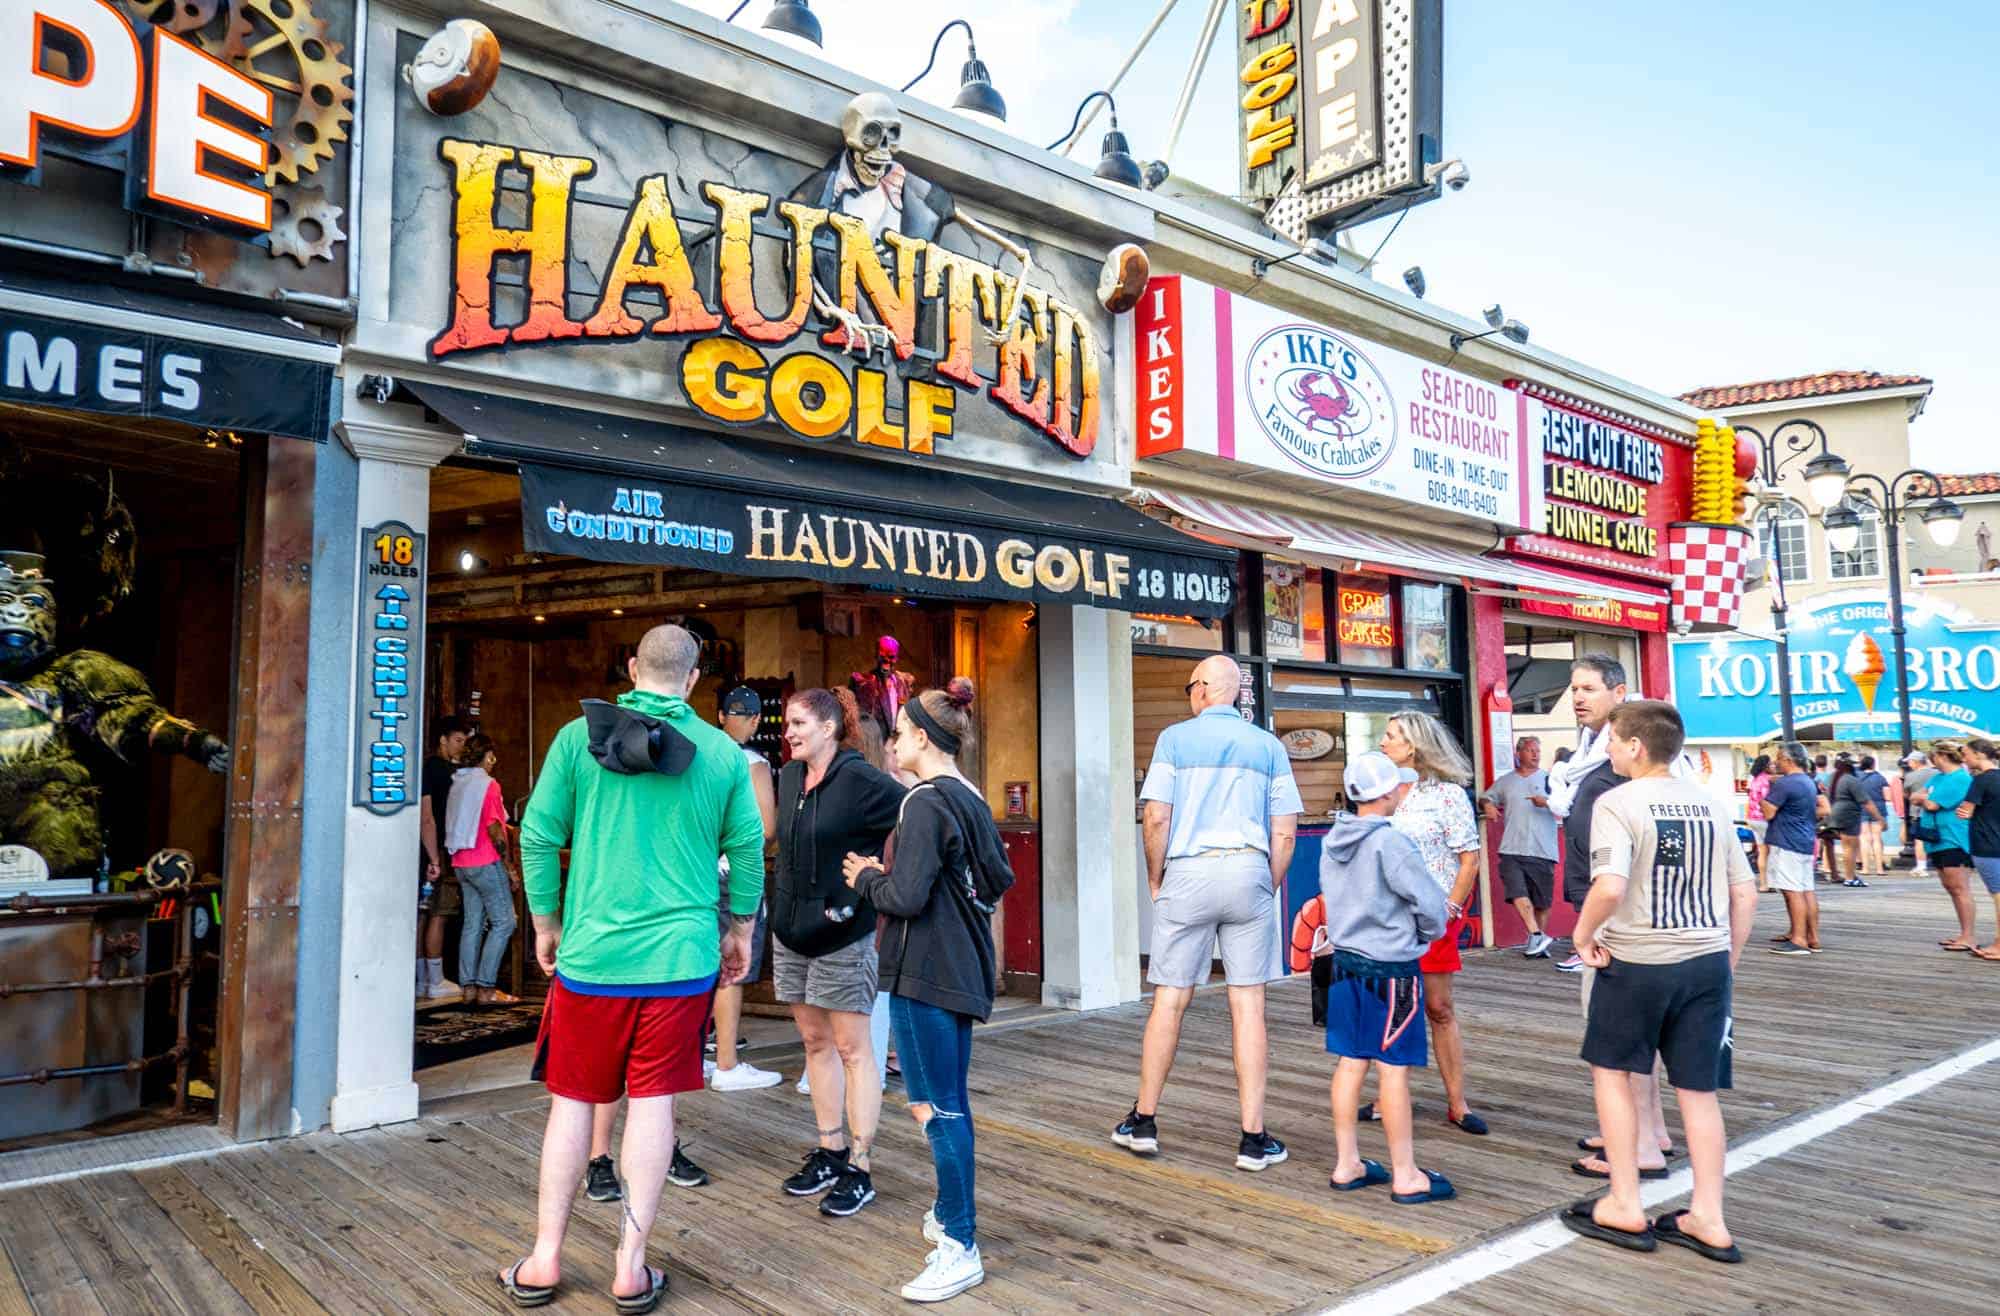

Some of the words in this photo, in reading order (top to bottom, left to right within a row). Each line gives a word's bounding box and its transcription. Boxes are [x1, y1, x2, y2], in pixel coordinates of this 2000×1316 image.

[1240, 42, 1297, 170] GOLF
[430, 138, 1099, 458] HAUNTED
[4, 330, 204, 411] MES
[1146, 288, 1176, 441] IKES
[1285, 334, 1357, 380] IKE'S
[682, 336, 956, 456] GOLF
[1421, 367, 1497, 421] SEAFOOD
[1266, 403, 1318, 459] Famous
[1320, 436, 1383, 466] Crabcakes
[1409, 401, 1511, 461] RESTAURANT
[1540, 408, 1584, 461] RESH
[1588, 422, 1620, 468] CUT
[1624, 432, 1664, 485] FRIES
[1413, 447, 1456, 478] DINE-IN
[1462, 461, 1509, 492] TAKE-OUT
[1551, 463, 1648, 518] LEMONADE
[612, 487, 665, 518] AIR
[1427, 479, 1498, 516] 609-840-6403
[375, 534, 414, 566] 18
[546, 506, 734, 555] CONDITIONED
[1543, 502, 1612, 549] FUNNEL
[1615, 520, 1657, 558] CAKE
[369, 562, 419, 578] HOLES
[744, 504, 987, 583] HAUNTED
[995, 538, 1131, 600] GOLF
[1137, 567, 1167, 599] 18
[1172, 570, 1231, 605] HOLES
[374, 583, 410, 631] AIR
[1341, 591, 1386, 617] CRAB
[1338, 619, 1393, 647] CAKES
[1697, 649, 1846, 697] KOHR
[1772, 698, 1841, 726] FOZEN
[1650, 803, 1711, 818] FREEDOM
